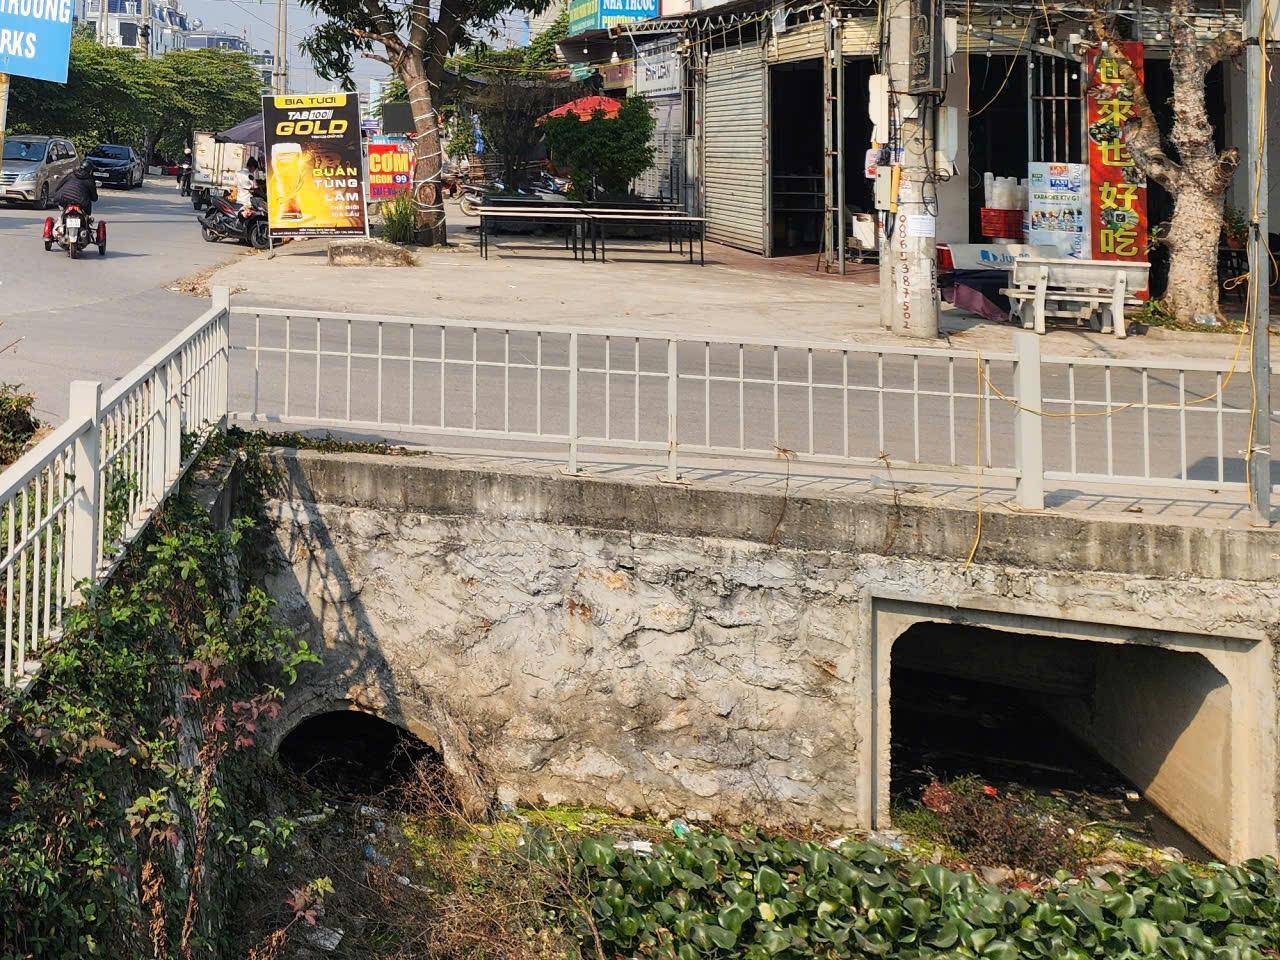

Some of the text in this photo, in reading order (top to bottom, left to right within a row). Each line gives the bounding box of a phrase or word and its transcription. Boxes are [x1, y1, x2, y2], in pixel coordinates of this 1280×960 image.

[285, 96, 337, 106] BIA TƯƠI
[276, 120, 348, 136] GOLD
[369, 151, 409, 173] CƠM
[314, 176, 358, 188] TÙNG
[395, 175, 408, 184] 99
[325, 190, 359, 201] LÂM
